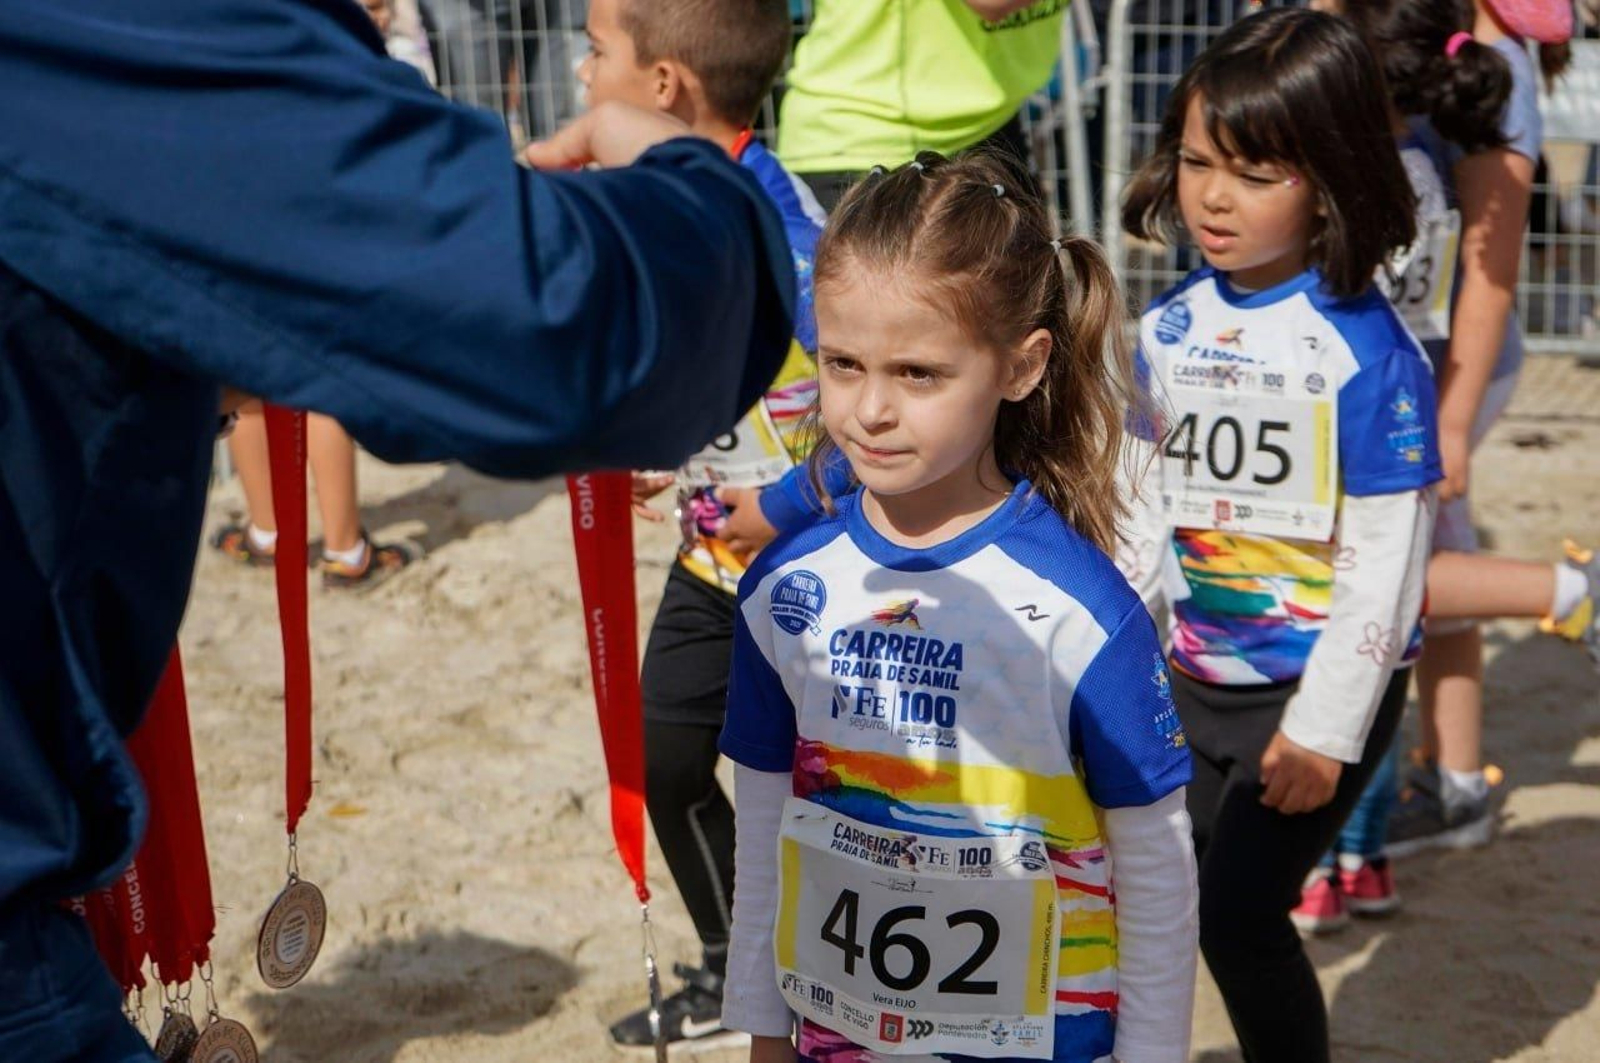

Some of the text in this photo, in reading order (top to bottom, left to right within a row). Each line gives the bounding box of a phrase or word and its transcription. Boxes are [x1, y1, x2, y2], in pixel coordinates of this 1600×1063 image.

[1262, 372, 1285, 388] 100
[1164, 412, 1292, 486] 405
[576, 475, 595, 530] VIGO
[829, 628, 963, 672] CARREIRA
[831, 659, 960, 691] PRAIA DE SAMIL
[900, 690, 956, 729] 100
[849, 716, 890, 731] seguros
[834, 822, 901, 857] CARREIRA
[830, 839, 900, 869] PRAIA DE SAMIL
[958, 847, 992, 866] 100
[821, 888, 1000, 995] 462
[810, 984, 835, 1006] 100
[873, 991, 917, 1009] Vera EIJO
[840, 1001, 875, 1023] CONCELLO
[843, 1011, 869, 1030] DE VIGO
[938, 1029, 988, 1040] Pontevedra
